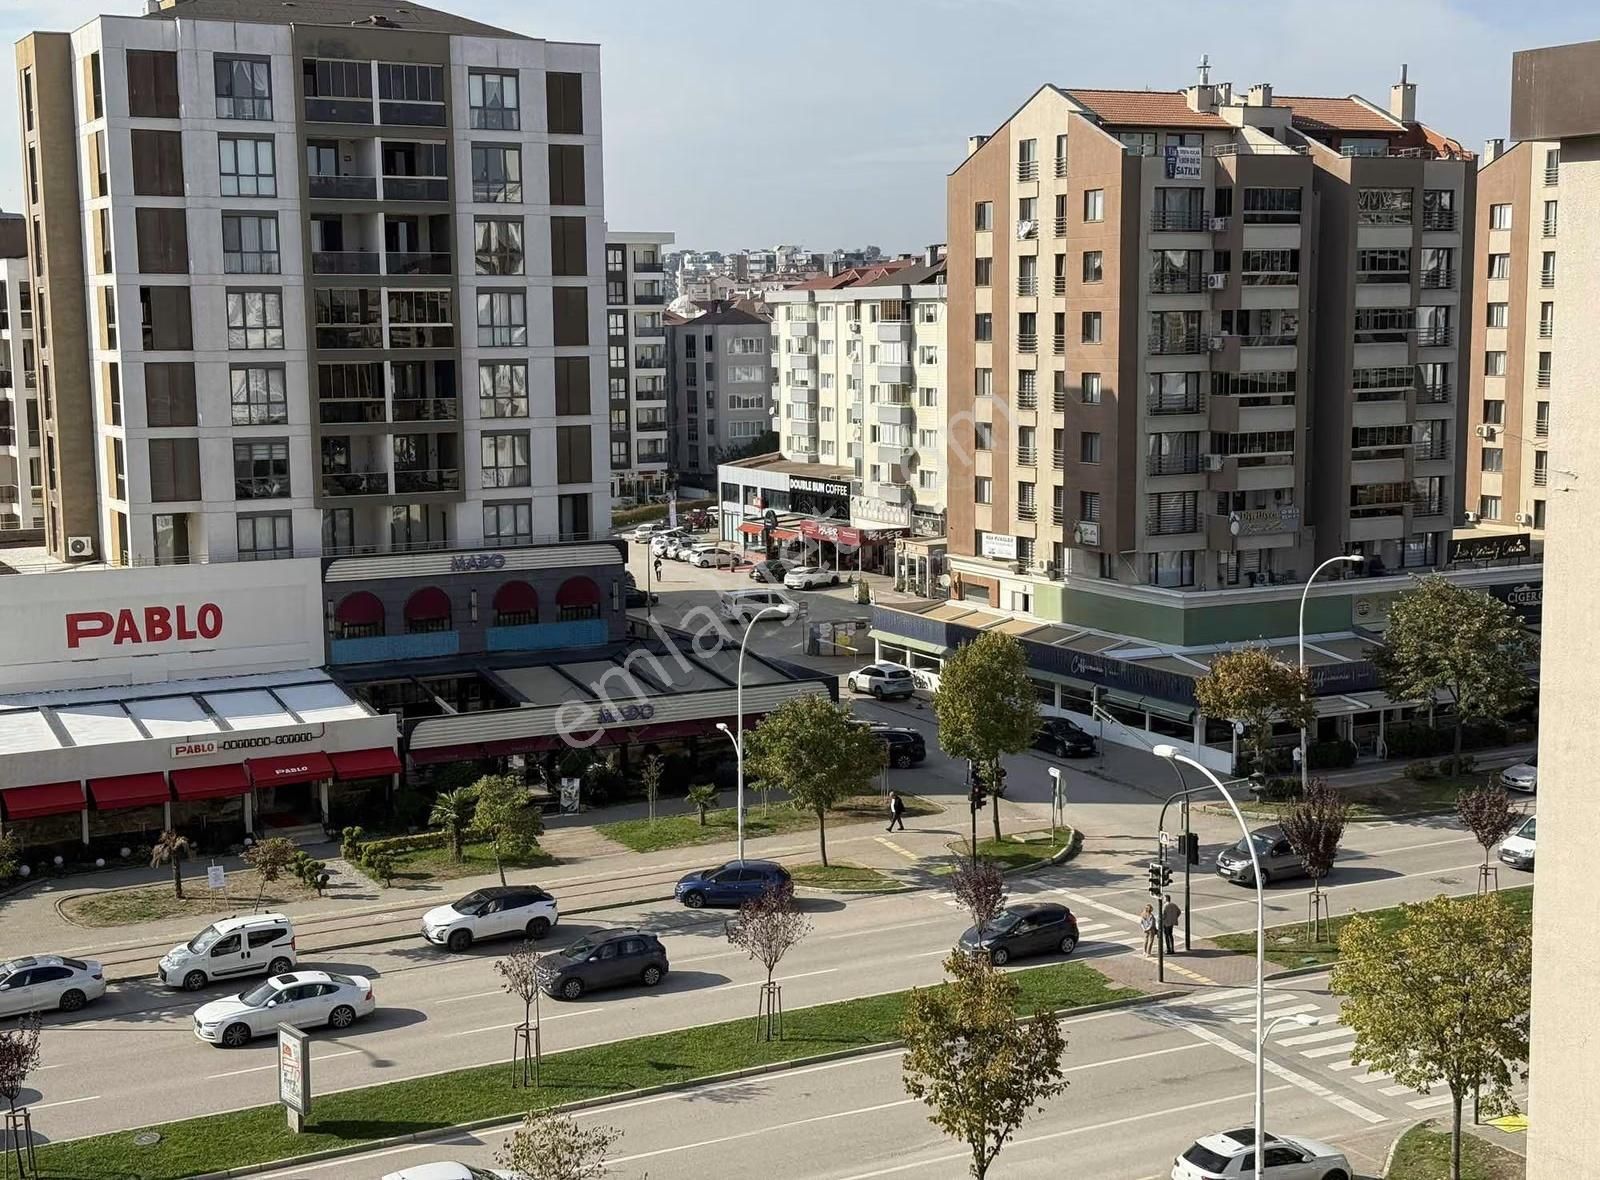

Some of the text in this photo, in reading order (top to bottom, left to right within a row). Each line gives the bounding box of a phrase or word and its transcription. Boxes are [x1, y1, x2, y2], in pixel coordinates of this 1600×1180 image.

[1176, 166, 1200, 176] SATILIK
[790, 478, 812, 490] DOUBLE
[825, 484, 848, 496] COFFEE
[450, 553, 506, 571] MADO
[66, 602, 223, 648] PABLO
[175, 742, 214, 756] PABLO
[275, 732, 312, 745] COFFEE
[275, 766, 308, 776] PABLO
